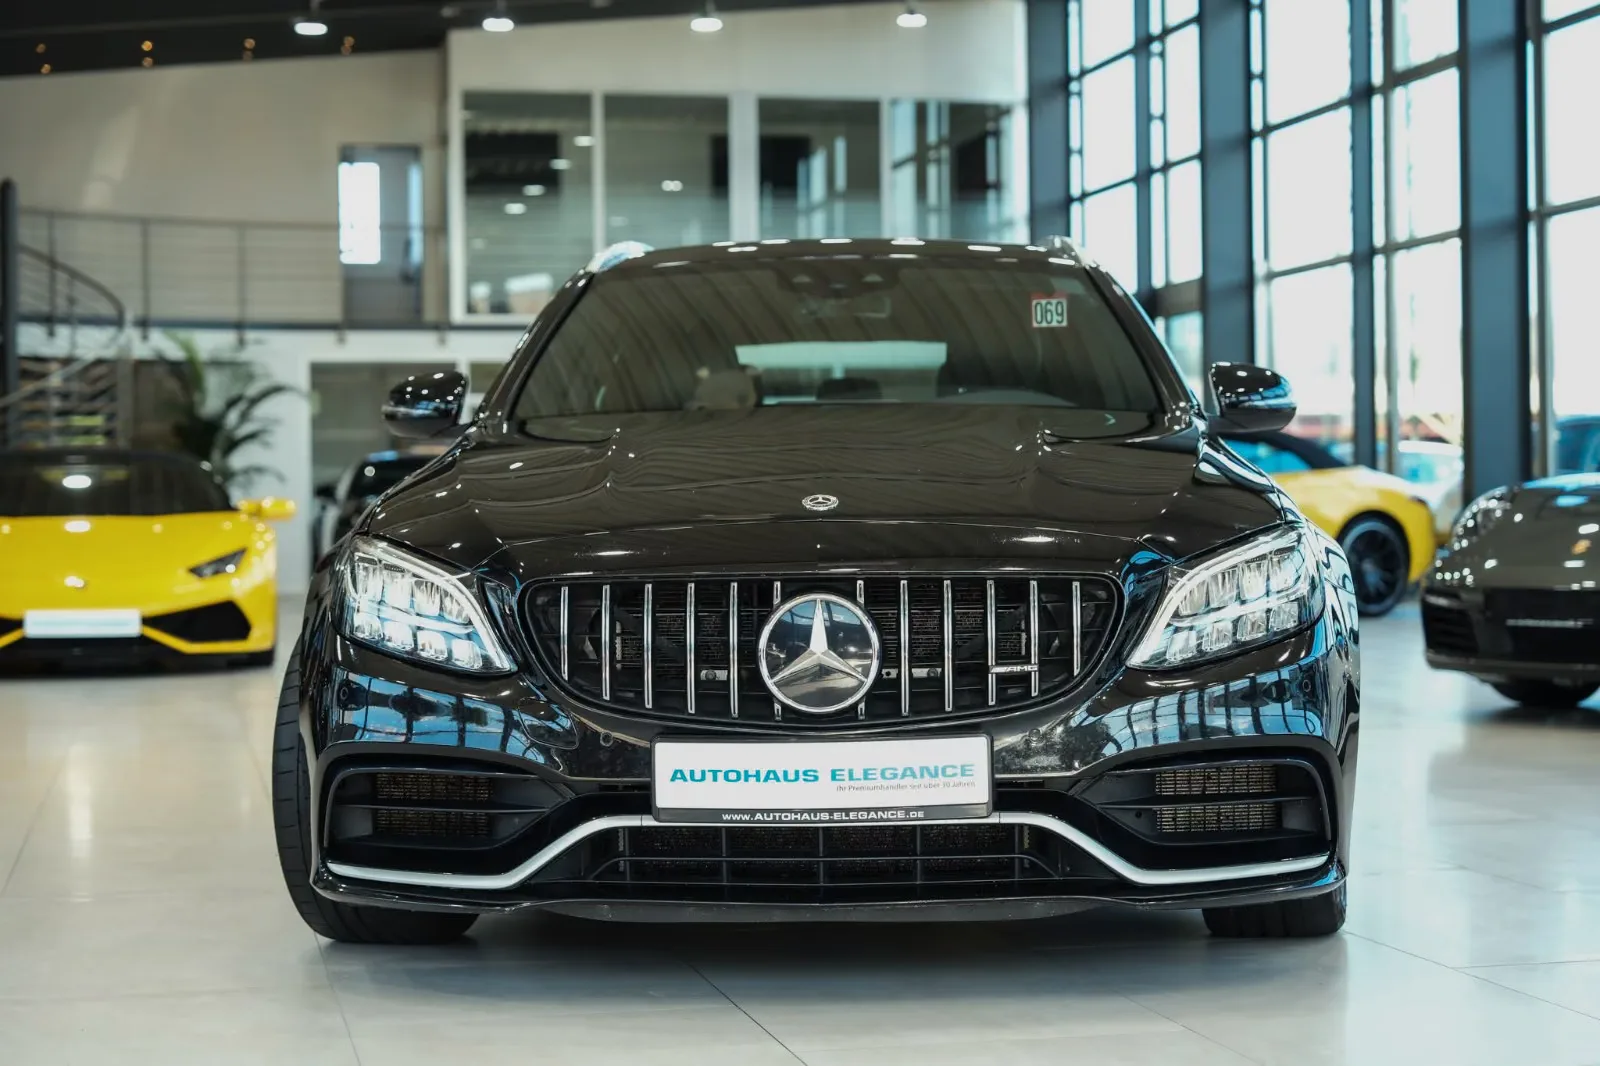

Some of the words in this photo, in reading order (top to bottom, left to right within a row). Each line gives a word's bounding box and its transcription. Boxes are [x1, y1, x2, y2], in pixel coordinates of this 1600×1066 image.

[1034, 301, 1065, 325] 069
[669, 769, 820, 783] AUTOHAUS
[830, 764, 975, 782] ELEGANCE
